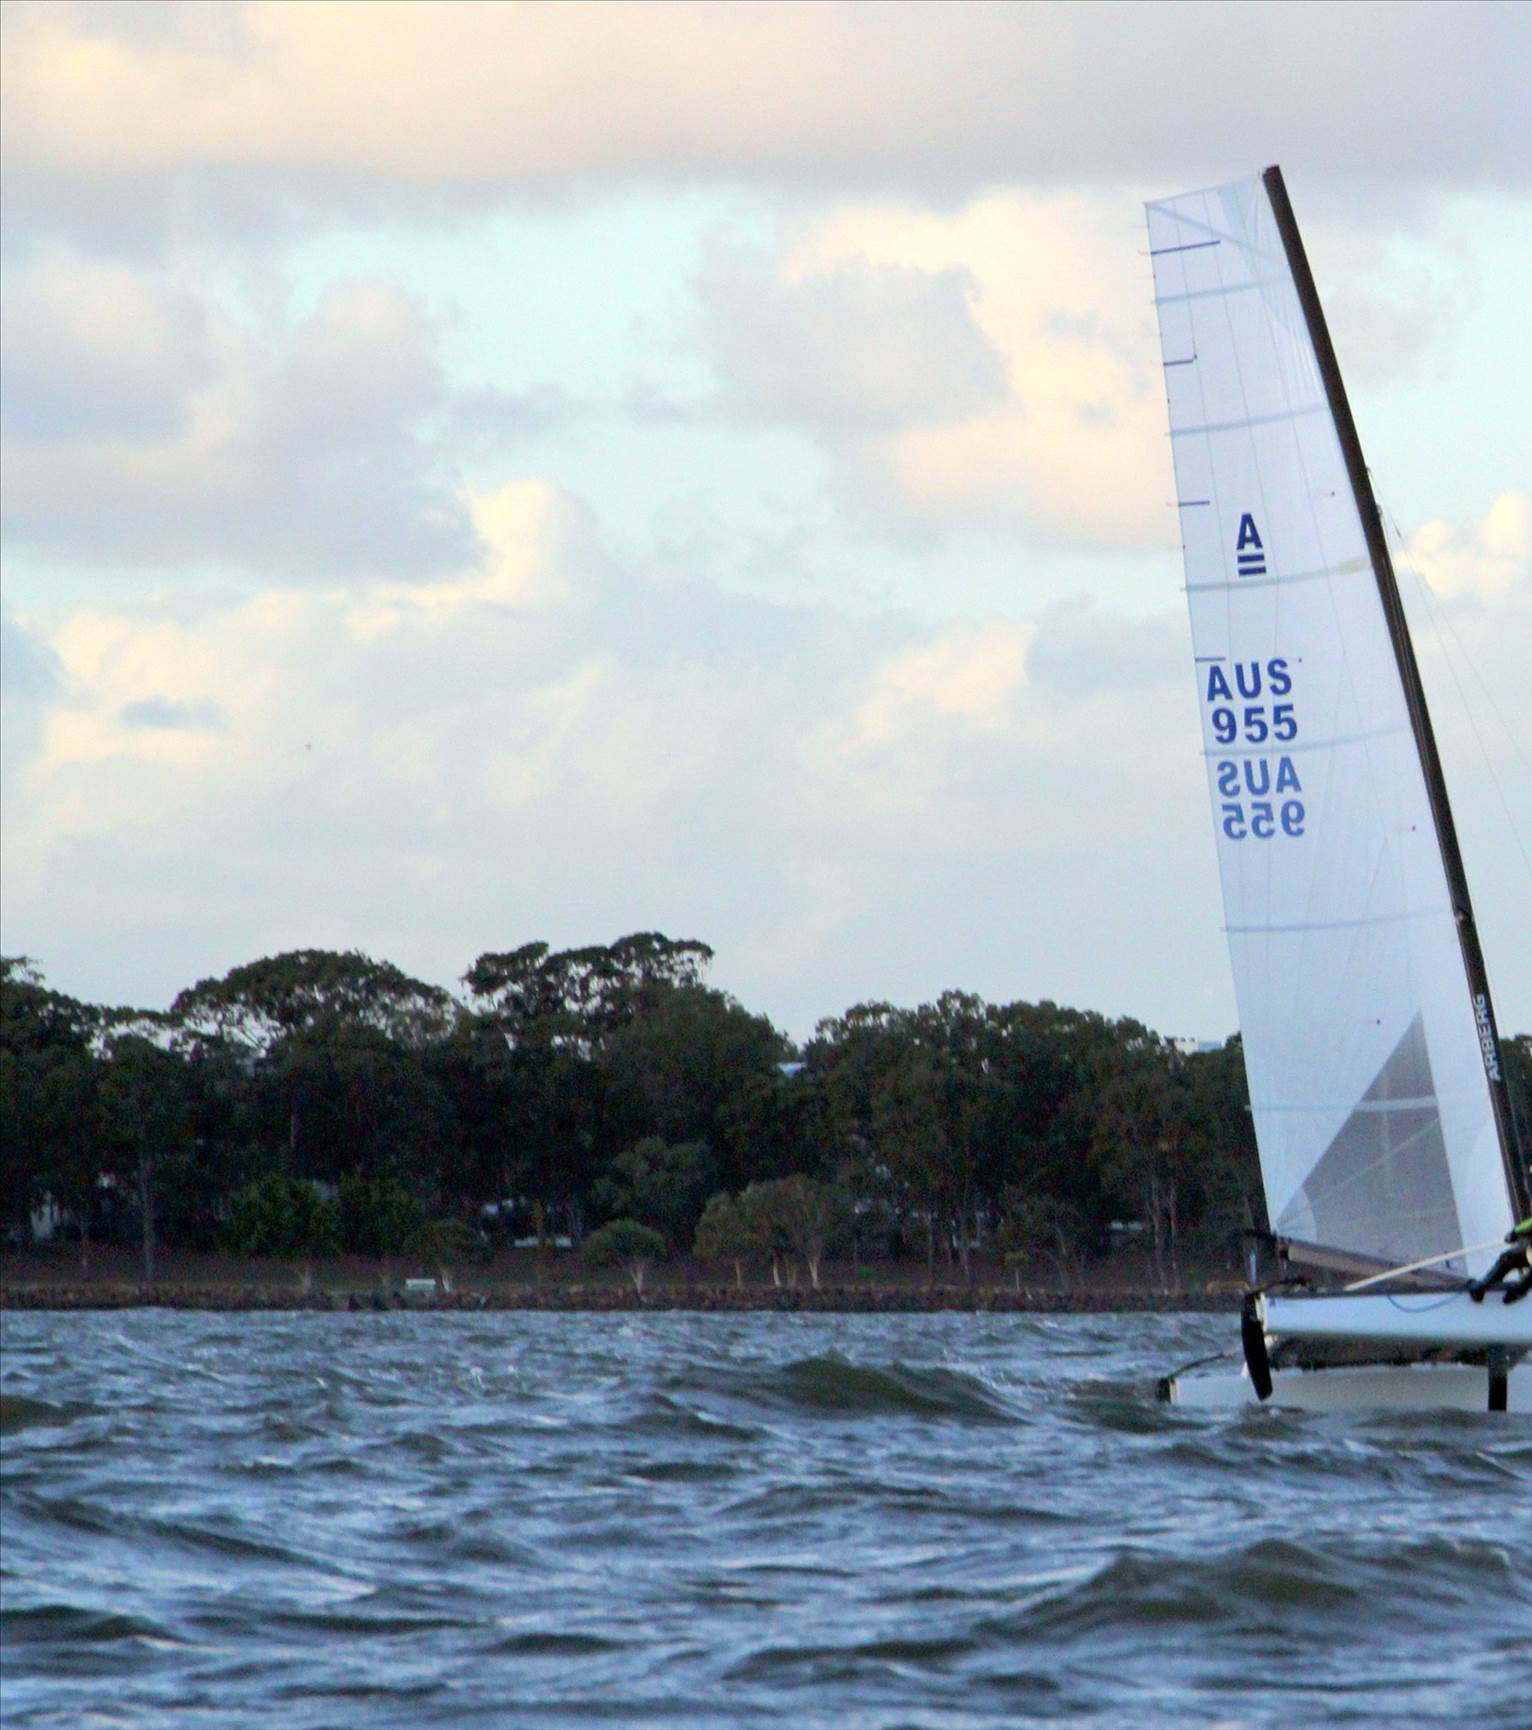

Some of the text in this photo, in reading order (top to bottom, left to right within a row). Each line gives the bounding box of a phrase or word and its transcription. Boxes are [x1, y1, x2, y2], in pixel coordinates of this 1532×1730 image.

[1236, 513, 1263, 550] A
[1207, 658, 1292, 701] AUS
[1211, 704, 1298, 744] 955
